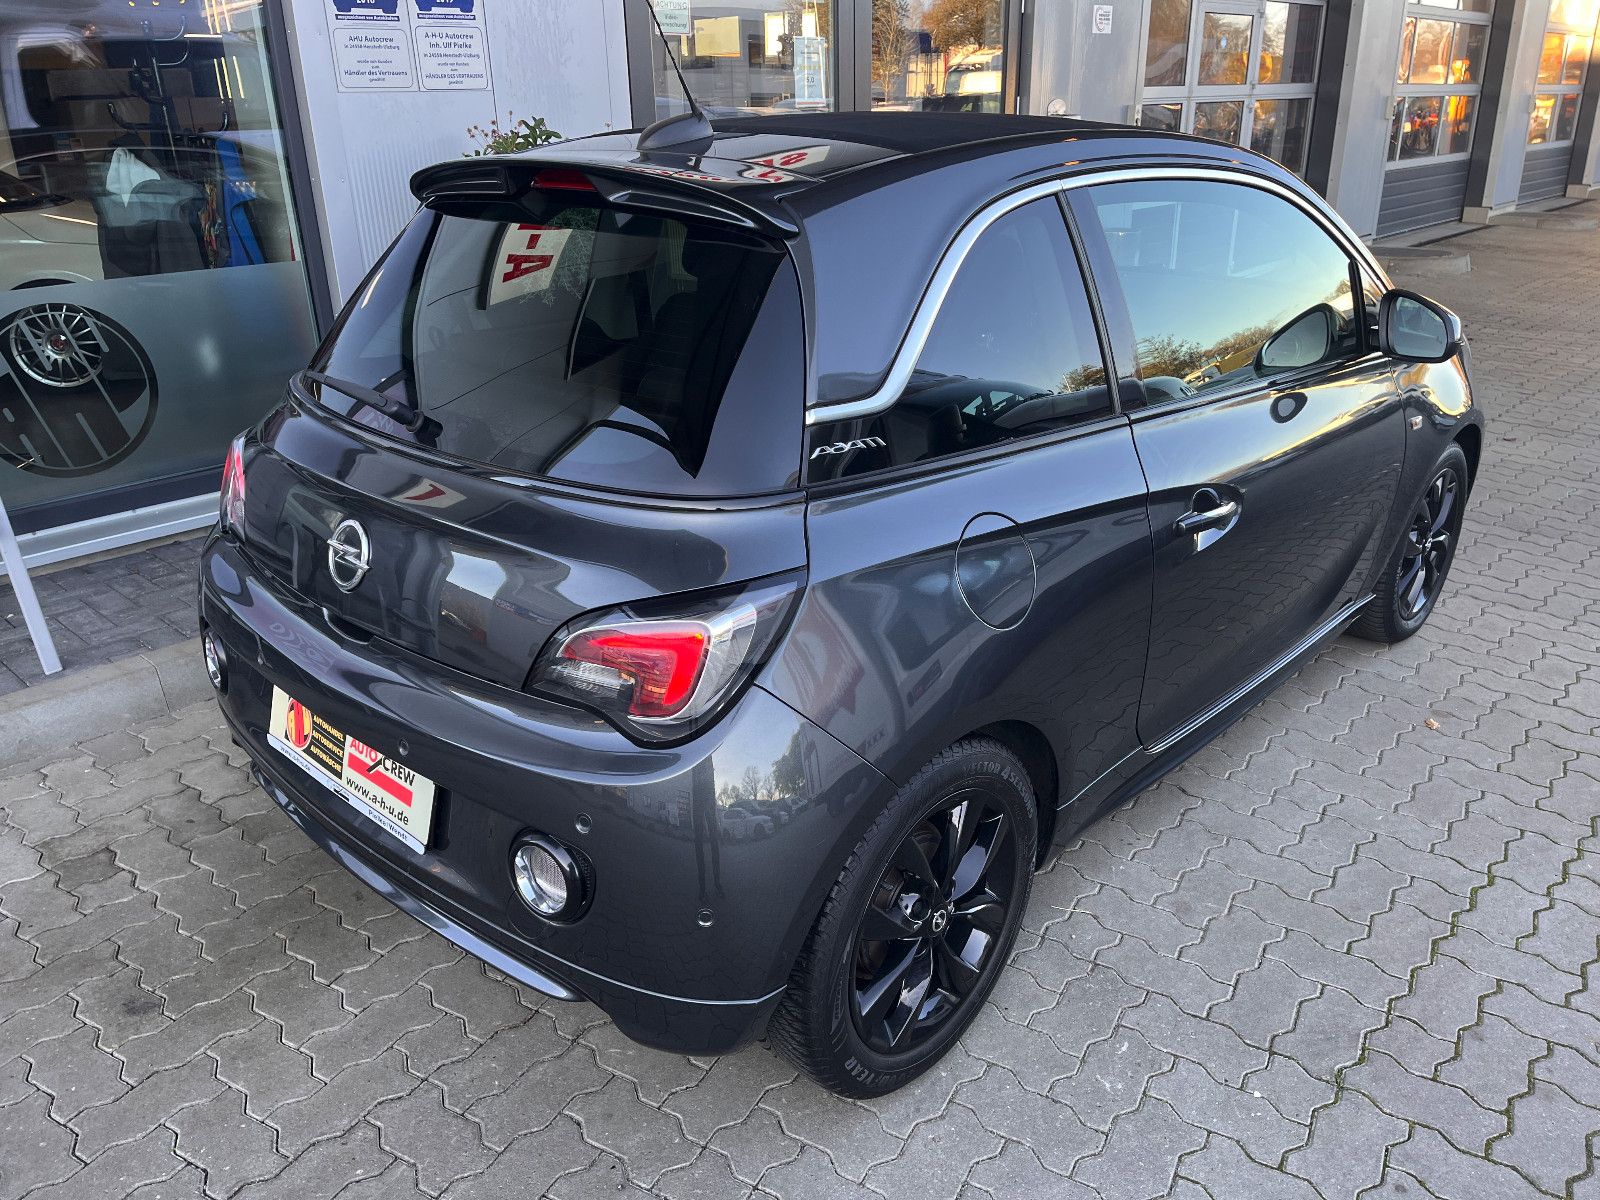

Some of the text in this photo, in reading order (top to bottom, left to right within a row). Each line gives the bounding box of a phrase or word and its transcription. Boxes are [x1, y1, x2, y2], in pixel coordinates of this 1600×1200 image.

[364, 35, 394, 43] Autocrew
[445, 32, 474, 40] Autocrew
[313, 714, 344, 742] AUTOHANDEL
[312, 729, 344, 758] AUTOSERVICE
[350, 738, 416, 787] AUTO CREW
[346, 776, 409, 826] www.a-h-u.de
